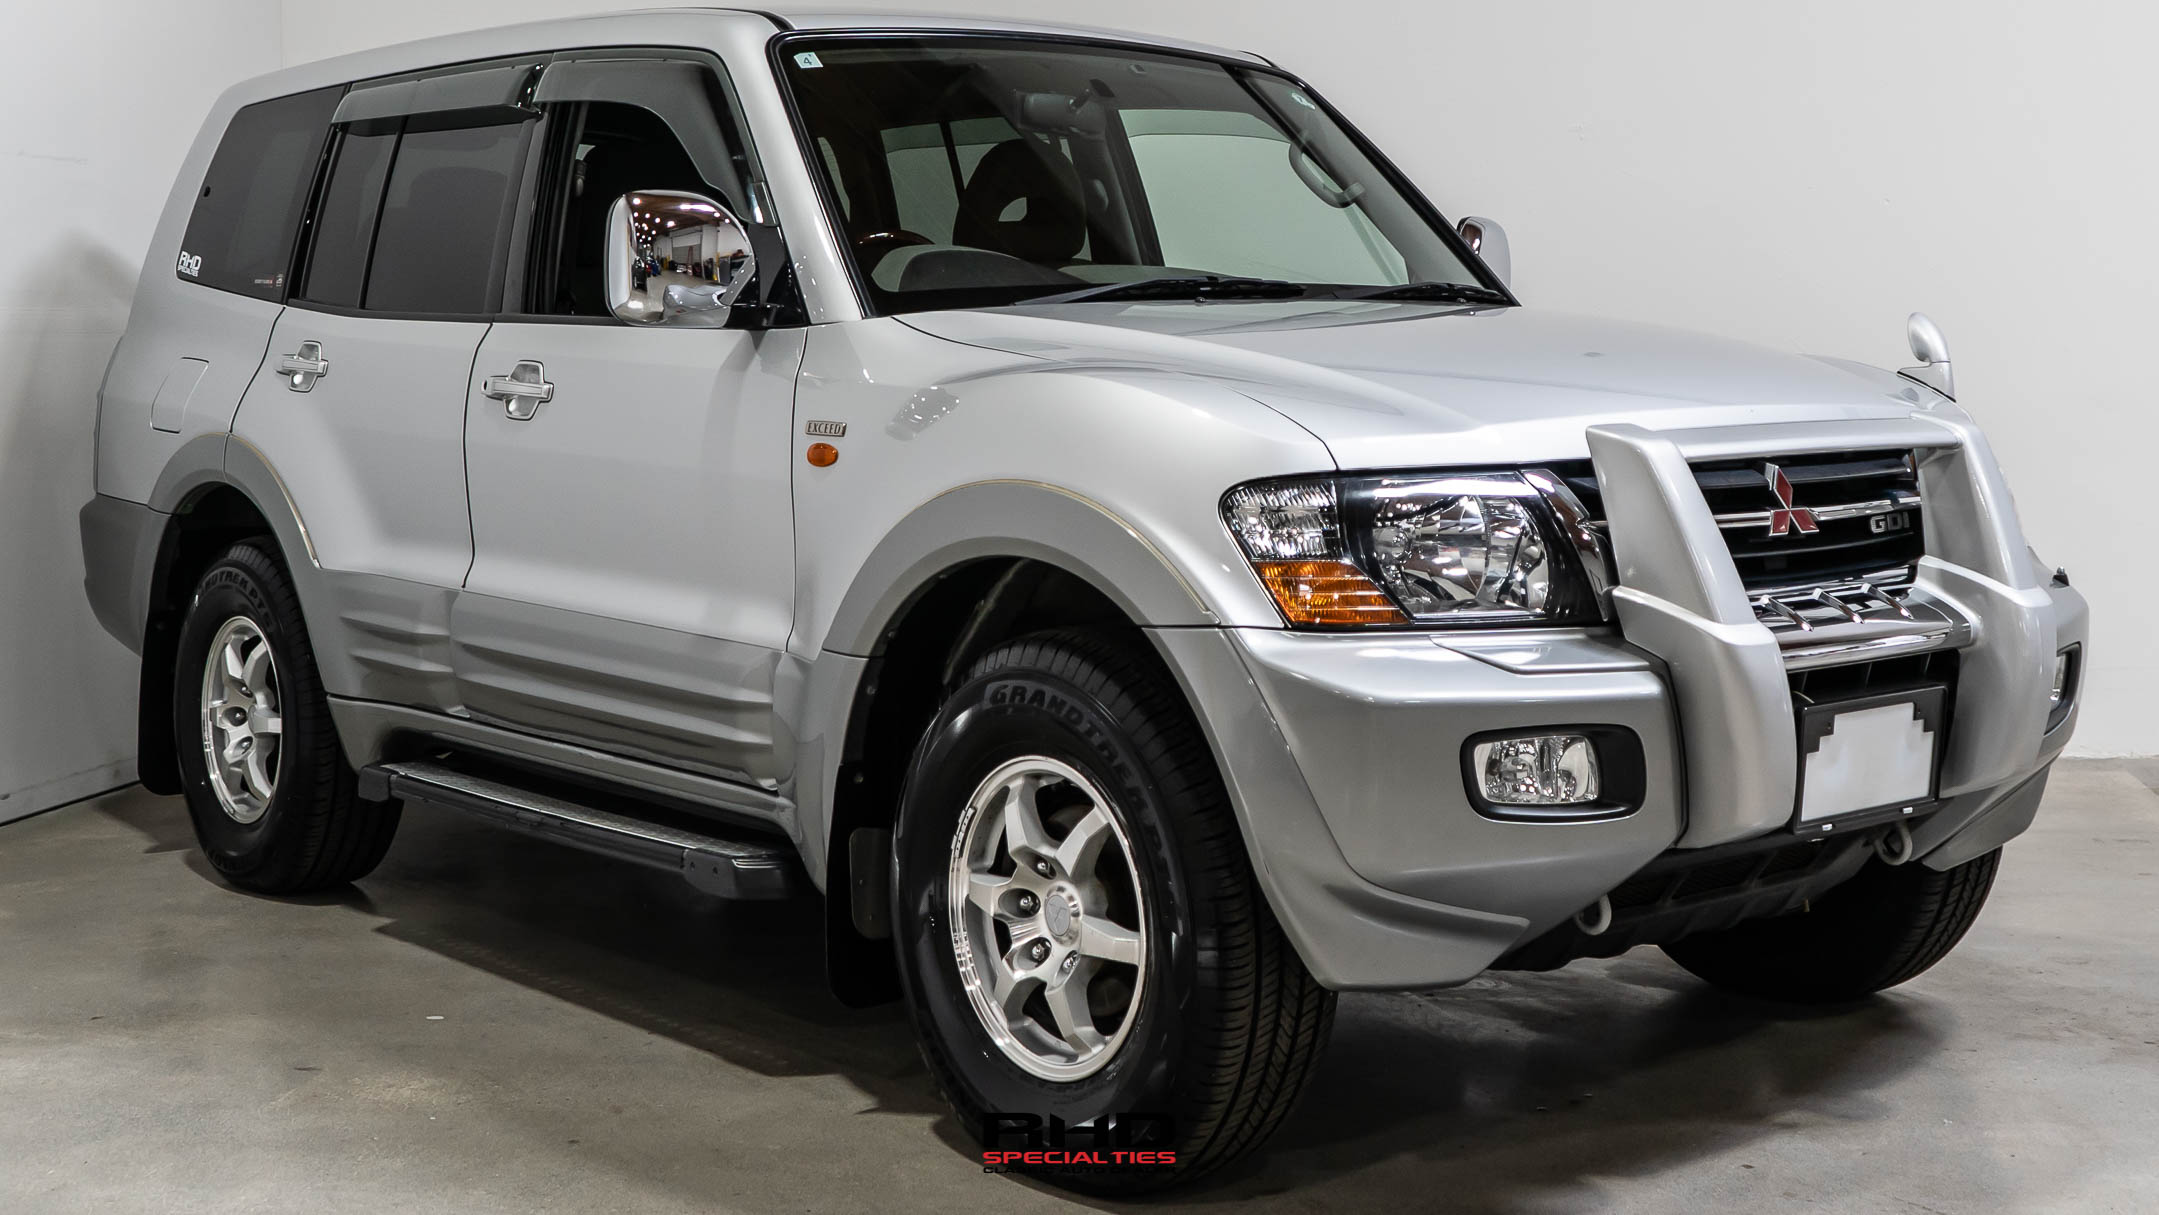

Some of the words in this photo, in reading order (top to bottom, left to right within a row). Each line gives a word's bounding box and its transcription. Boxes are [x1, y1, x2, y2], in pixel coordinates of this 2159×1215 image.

[178, 250, 202, 271] RHD
[807, 422, 841, 435] EXCEED
[1870, 511, 1910, 534] GDI
